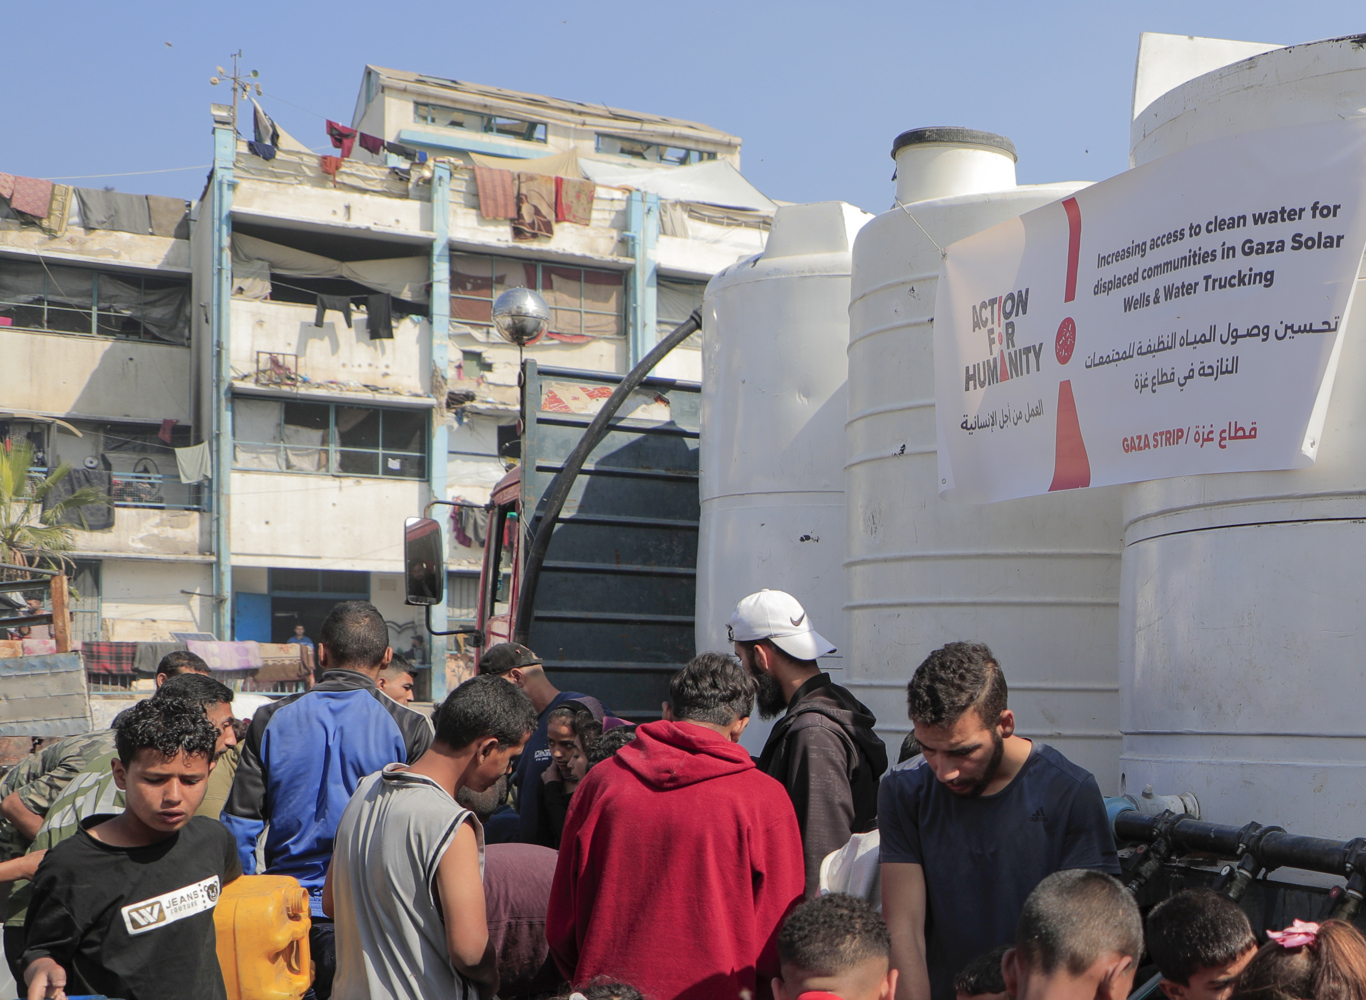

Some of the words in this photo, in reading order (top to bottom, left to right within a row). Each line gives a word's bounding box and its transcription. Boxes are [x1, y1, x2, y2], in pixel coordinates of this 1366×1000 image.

[1097, 240, 1147, 269] Increasing
[1149, 228, 1185, 251] access
[1188, 222, 1202, 238] to
[1205, 215, 1247, 234] clean
[1252, 206, 1306, 226] water
[1311, 201, 1341, 219] for
[1093, 267, 1139, 296] displaced
[1141, 246, 1217, 281] communities
[1241, 238, 1285, 257] Gaza
[1290, 231, 1345, 251] Solar
[1123, 292, 1151, 313] Wells
[1153, 288, 1161, 305] &
[1163, 281, 1199, 302] Water
[1203, 267, 1275, 292] Trucking
[972, 288, 1029, 332] ACTION
[965, 343, 1043, 391] HUMANITY
[1151, 367, 1175, 394] قطاع
[1177, 362, 1195, 392] في
[1198, 356, 1239, 381] النازحة
[1134, 371, 1149, 394] غزة
[999, 402, 1011, 429] أجل
[1012, 408, 1023, 426] من
[1024, 399, 1044, 423] العمل
[1122, 434, 1151, 453] GAZA
[1193, 423, 1215, 449] غزة
[1218, 421, 1258, 449] قطاع
[165, 890, 199, 909] JEANS
[170, 901, 198, 915] COUTURE
